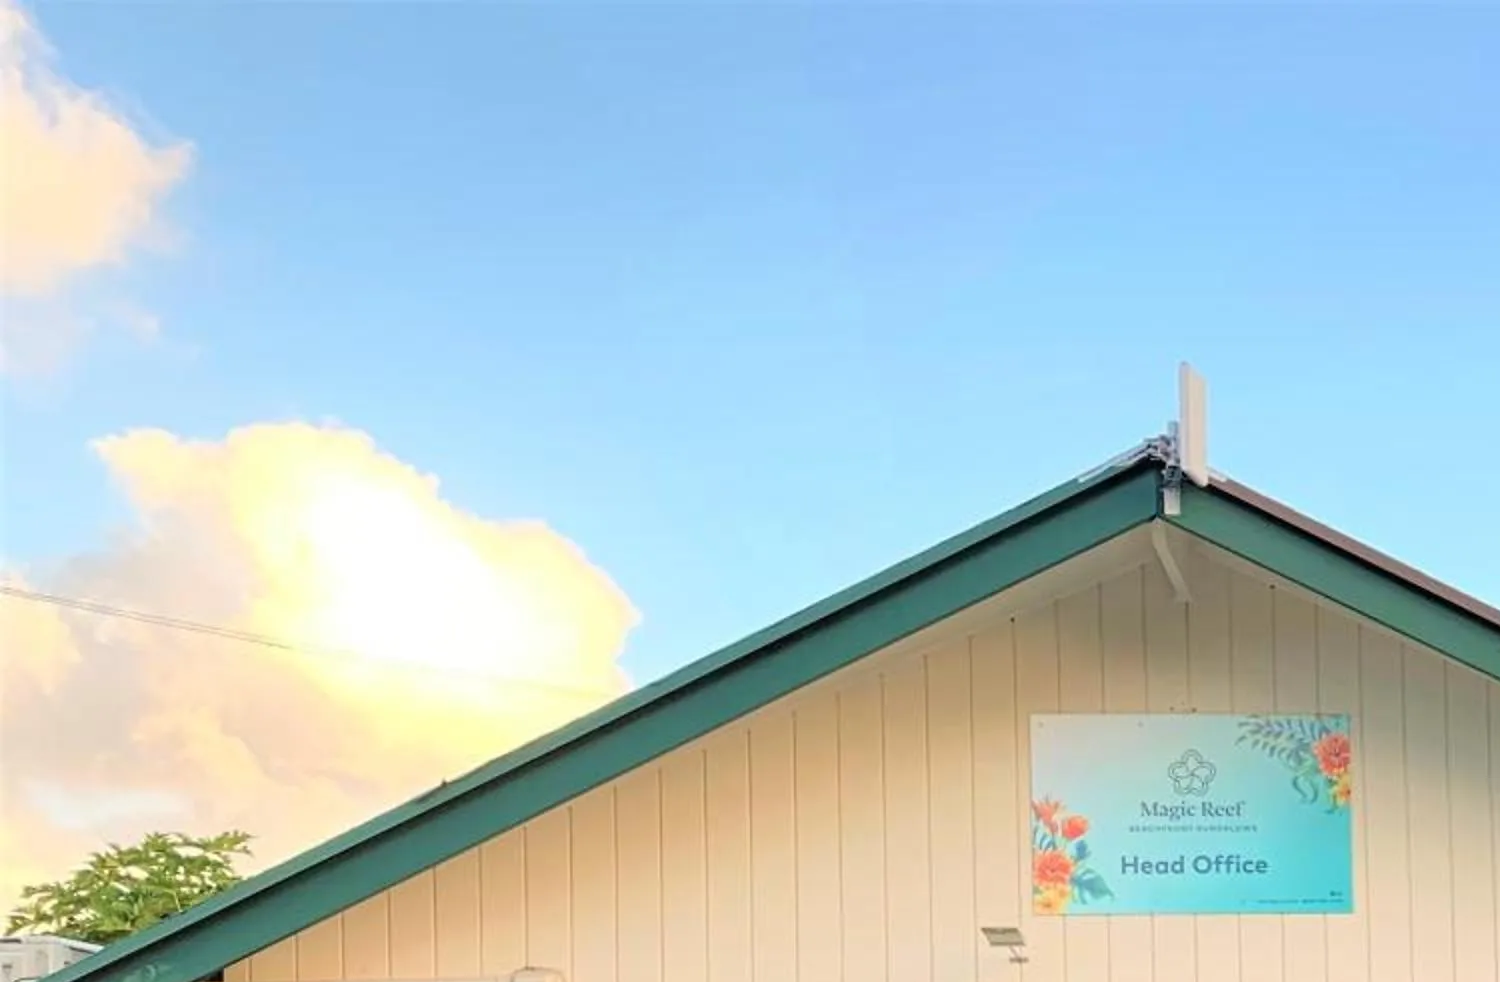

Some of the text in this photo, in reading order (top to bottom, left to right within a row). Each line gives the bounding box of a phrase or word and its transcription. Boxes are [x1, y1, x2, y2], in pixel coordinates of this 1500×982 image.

[1140, 800, 1246, 820] Magic Reef
[1121, 854, 1269, 875] Head Office
